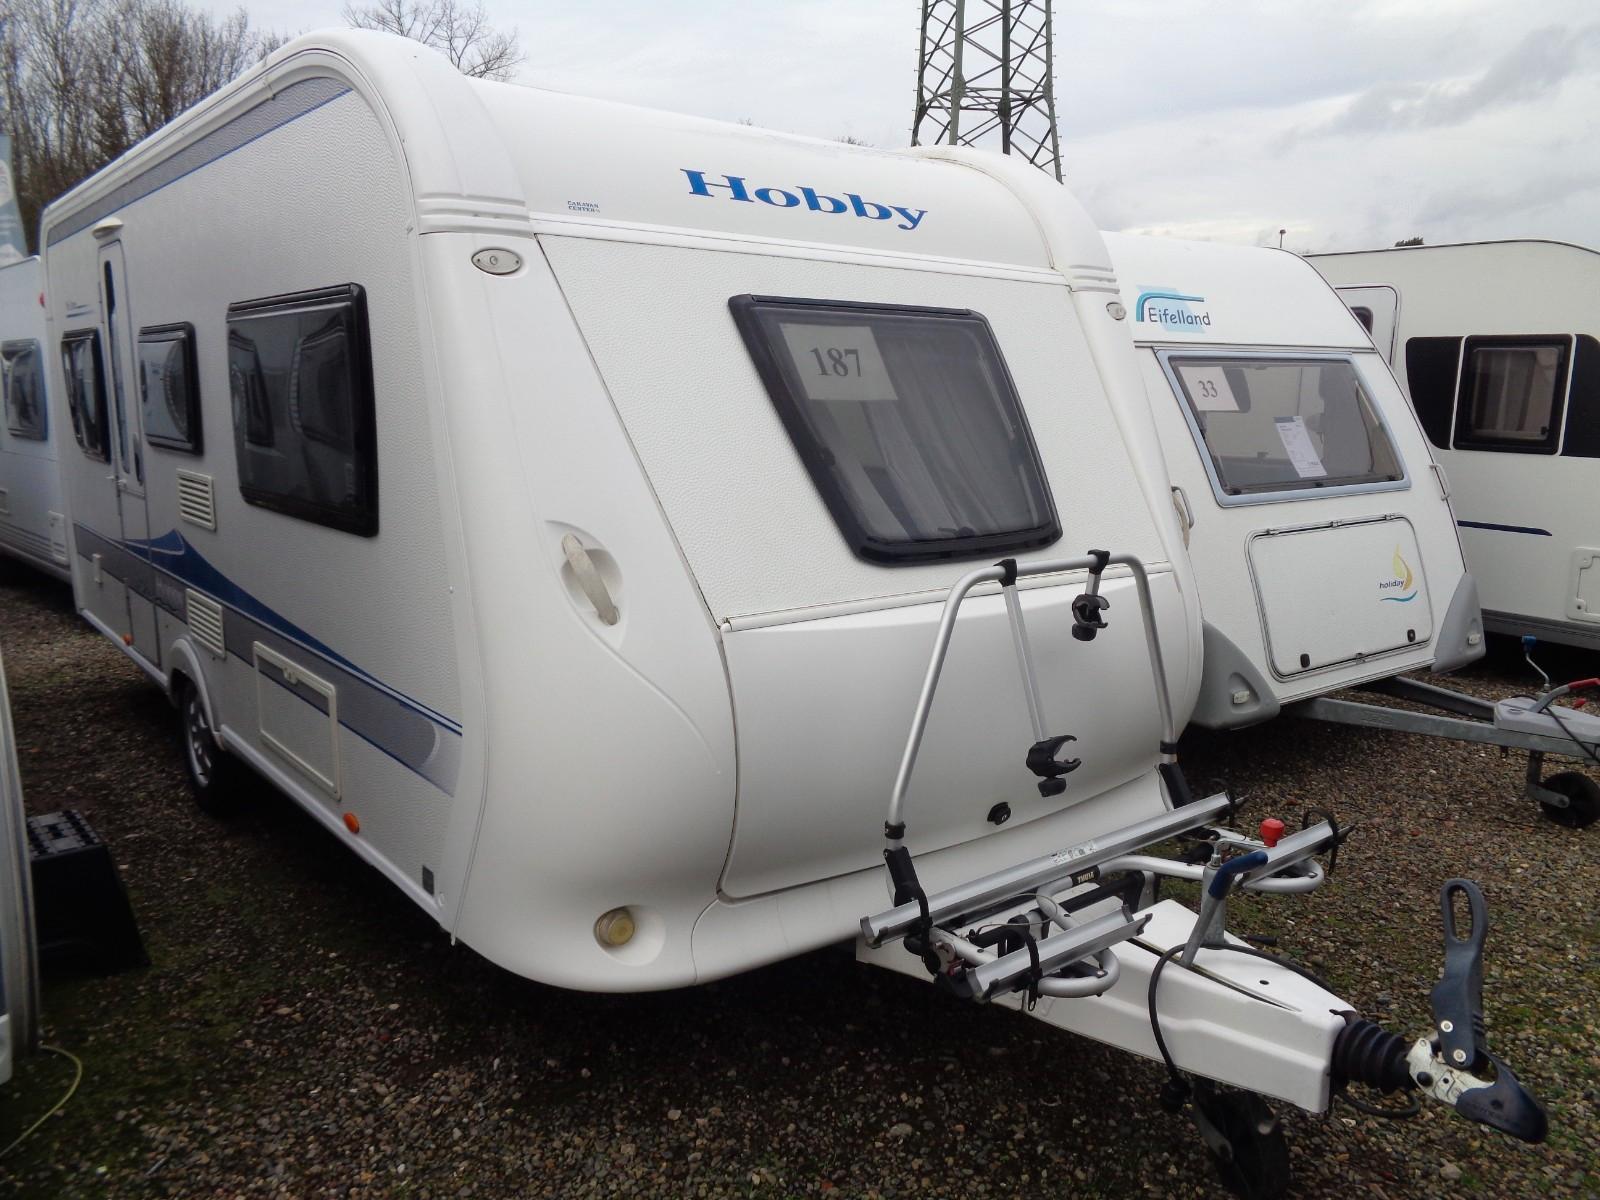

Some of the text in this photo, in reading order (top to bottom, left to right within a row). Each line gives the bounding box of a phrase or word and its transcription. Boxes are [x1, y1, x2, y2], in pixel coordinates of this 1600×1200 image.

[567, 200, 599, 208] CARAVAN
[680, 168, 928, 231] Hobby
[1148, 307, 1211, 326] Eifelland
[809, 347, 862, 378] 187
[1198, 380, 1218, 398] 33
[1379, 579, 1405, 589] holiday
